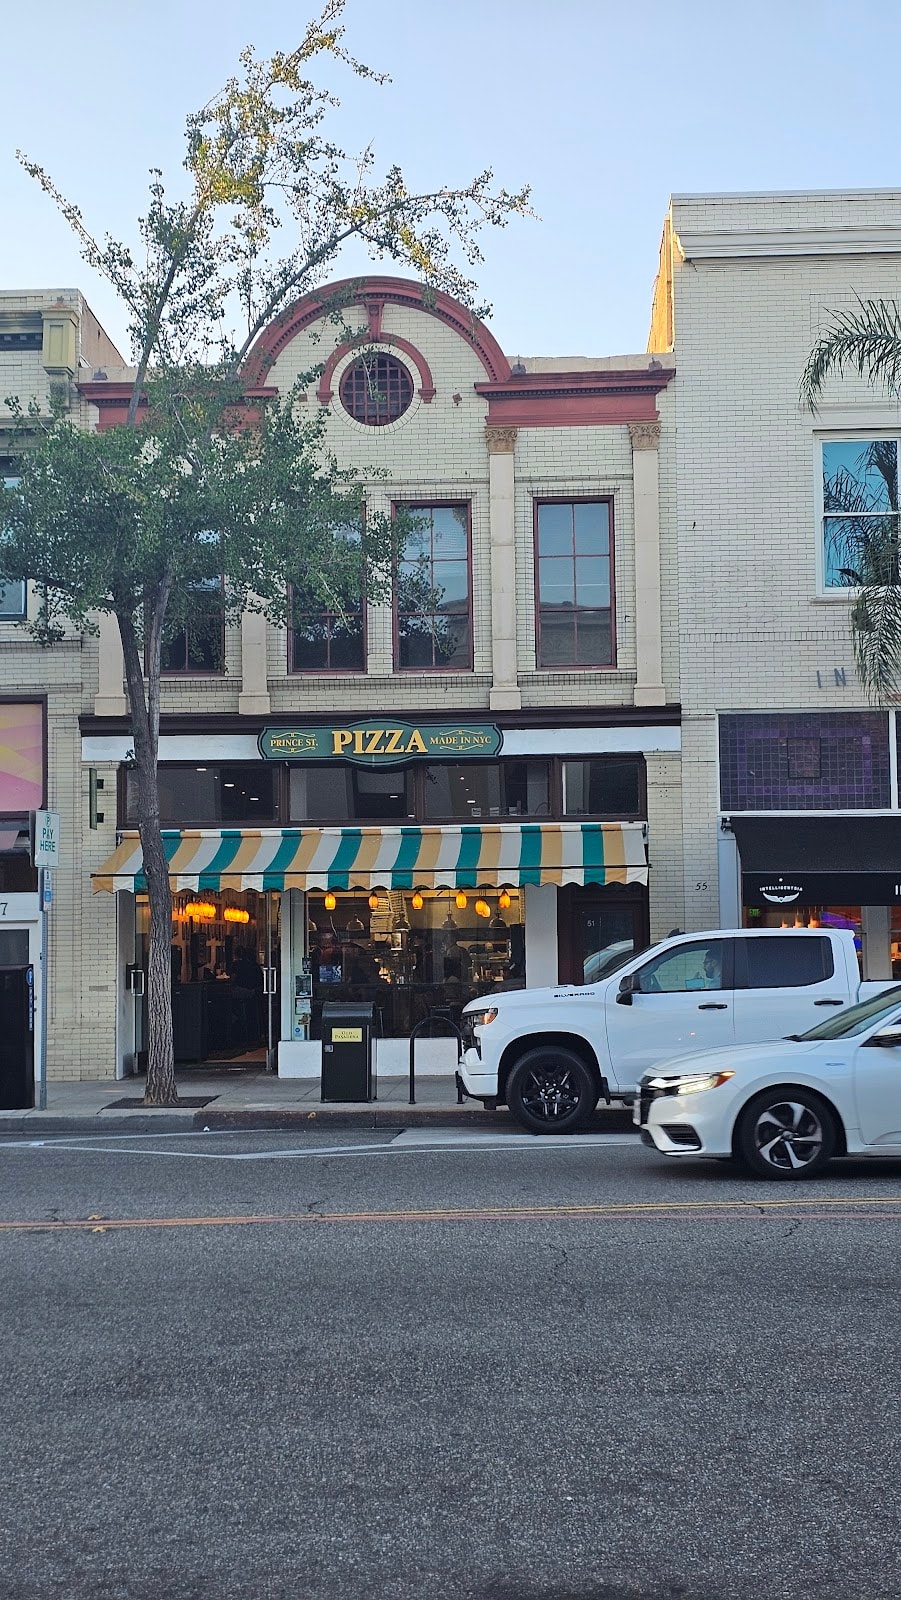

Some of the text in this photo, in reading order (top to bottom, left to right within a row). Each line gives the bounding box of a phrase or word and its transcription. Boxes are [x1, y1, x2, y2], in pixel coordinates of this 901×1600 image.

[270, 738, 319, 747] PRINCE ST.
[331, 729, 429, 755] PIZZA
[430, 736, 492, 745] MADE IN NYC
[42, 828, 54, 840] PAY
[40, 841, 56, 852] HERE
[695, 881, 708, 891] 55
[586, 919, 595, 927] 51
